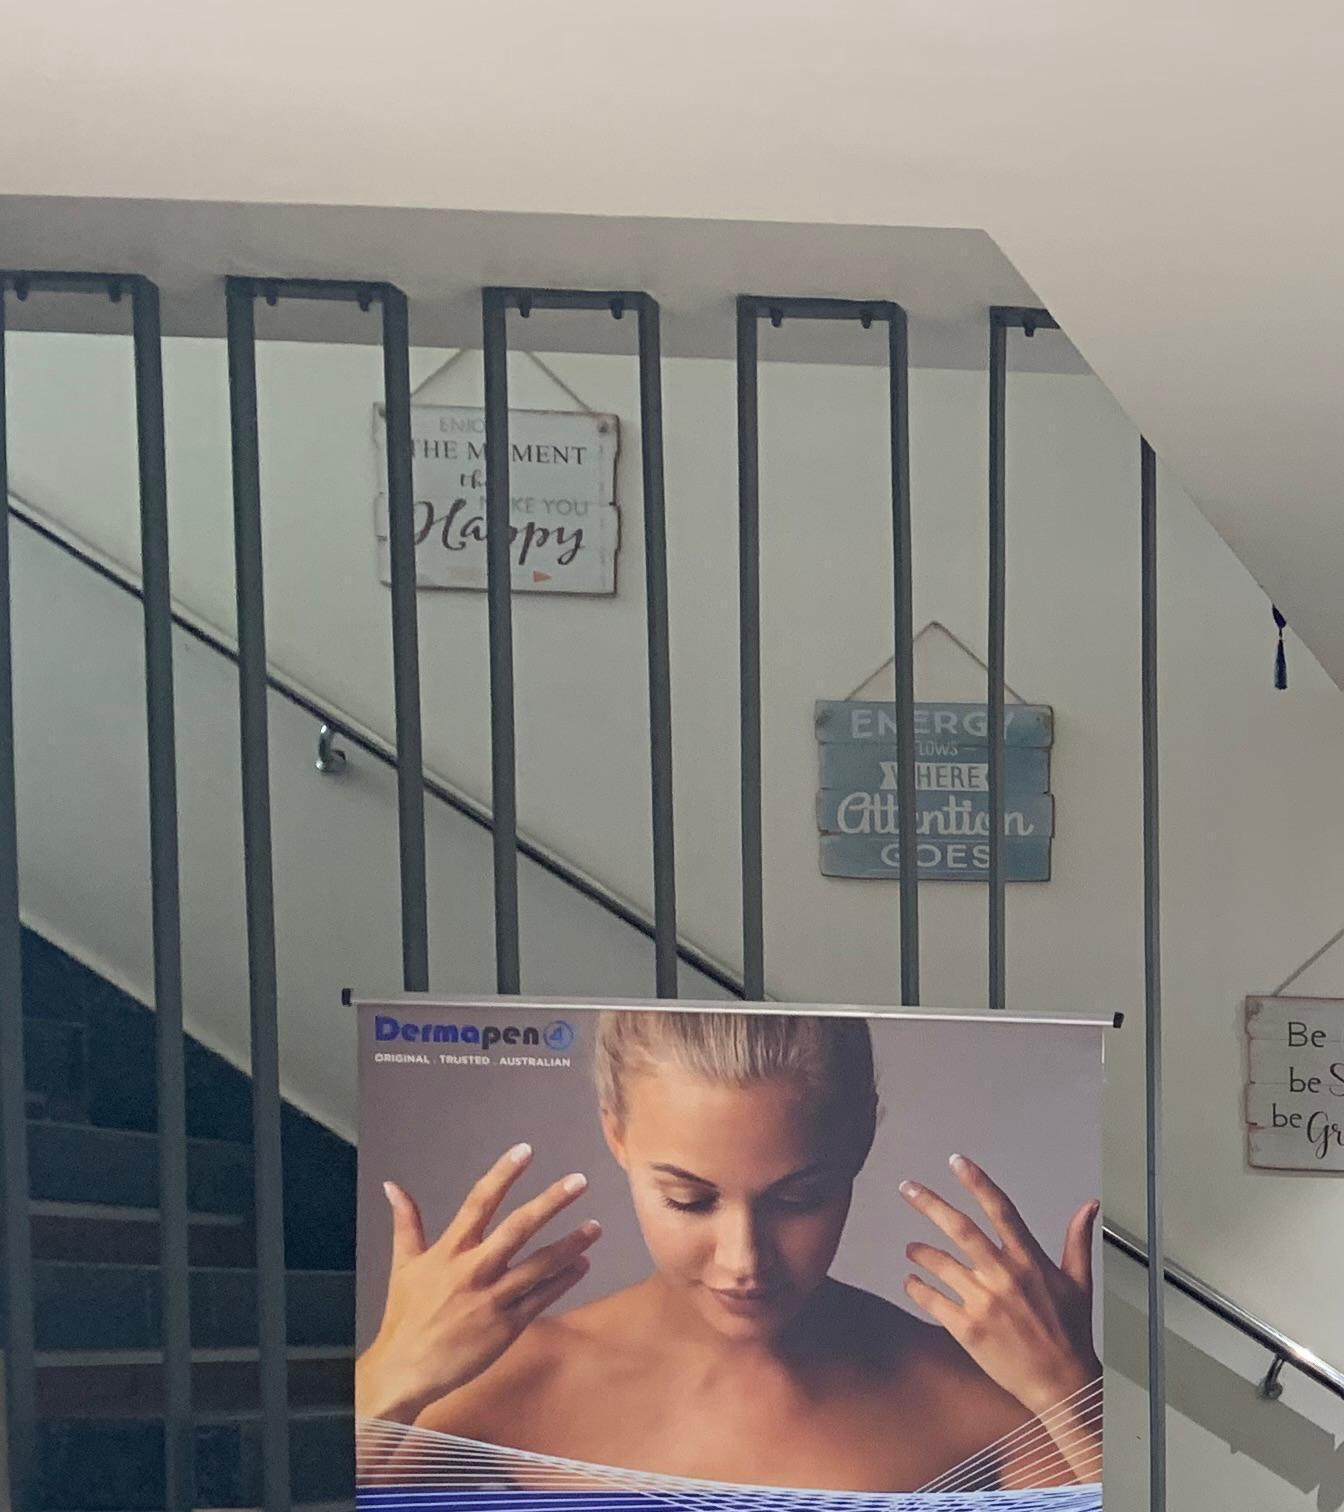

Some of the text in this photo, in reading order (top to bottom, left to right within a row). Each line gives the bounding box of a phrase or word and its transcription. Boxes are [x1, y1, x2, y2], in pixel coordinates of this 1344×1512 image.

[467, 441, 587, 465] MMENT
[543, 498, 588, 516] YOU
[913, 740, 958, 756] LOWS
[890, 764, 980, 789] HERE
[836, 792, 1035, 836] Attntion
[375, 1015, 539, 1050] Dermapen
[1288, 1022, 1327, 1048] Be
[375, 1053, 571, 1068] ORIGINAL TRUSTED AUSTRALIAN
[1289, 1066, 1322, 1093] be
[1272, 1103, 1302, 1128] be
